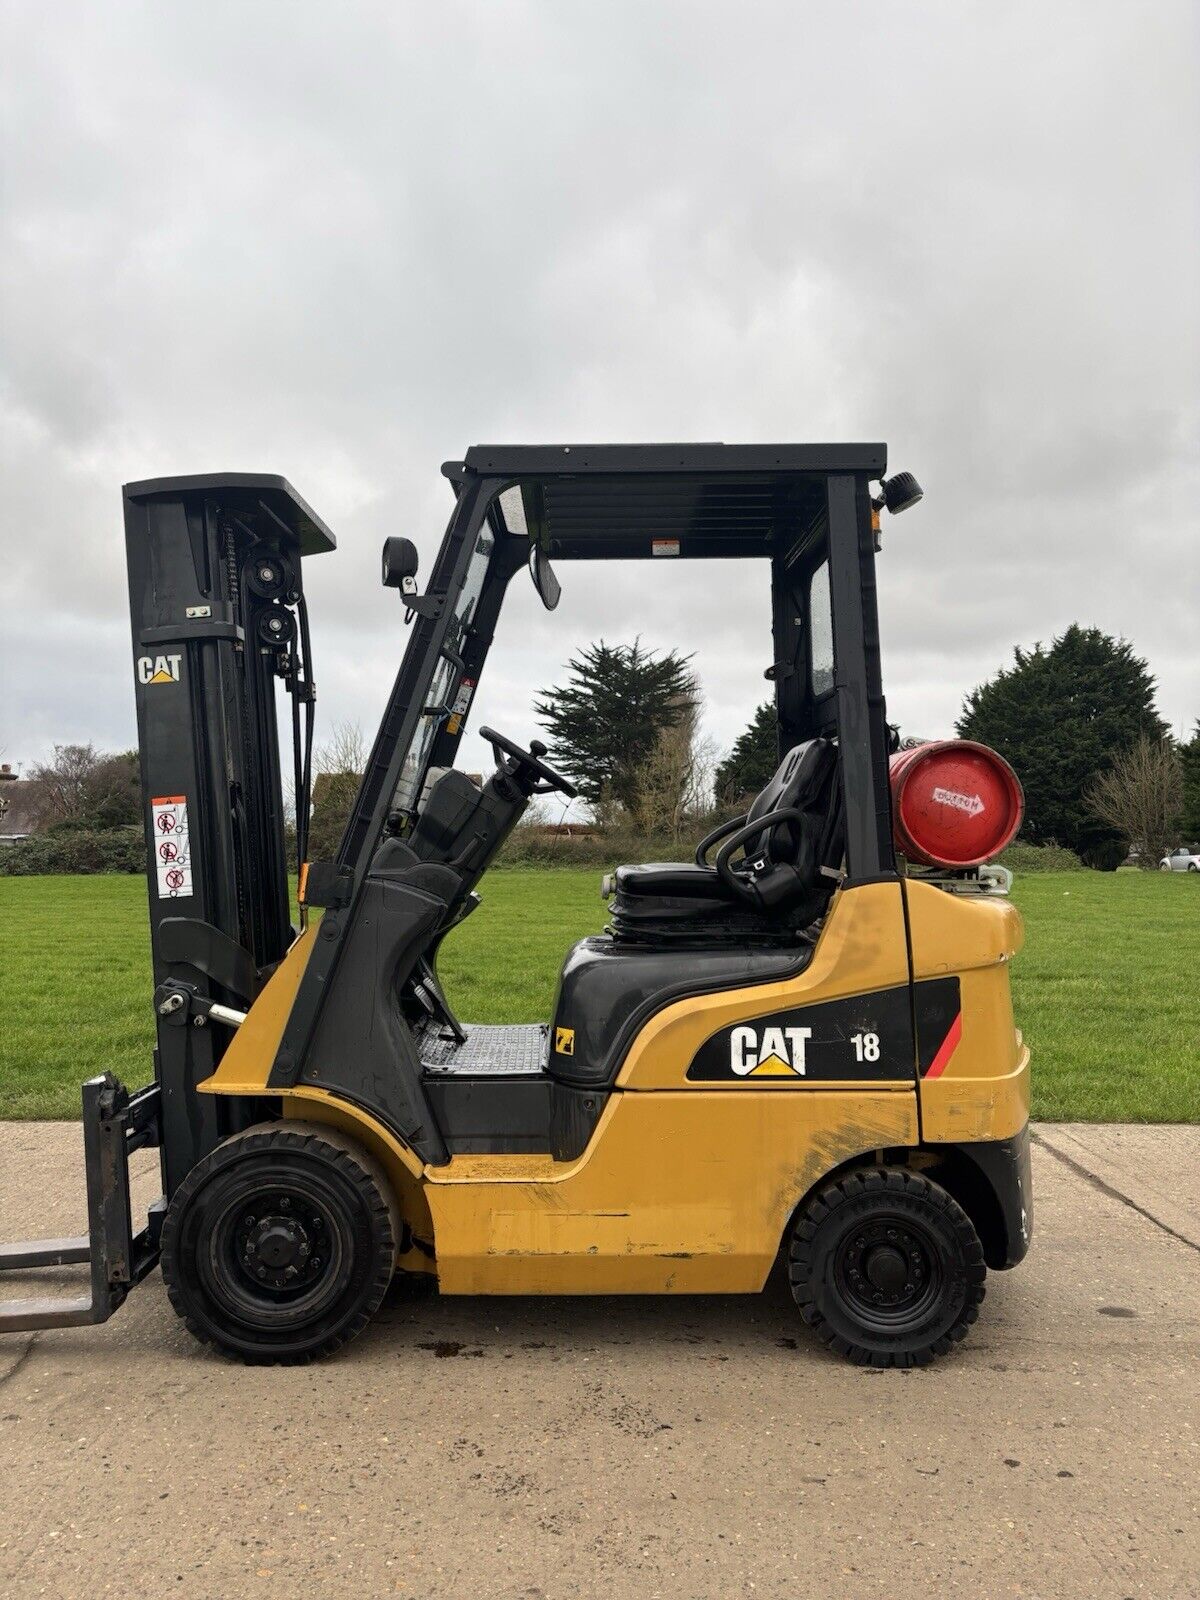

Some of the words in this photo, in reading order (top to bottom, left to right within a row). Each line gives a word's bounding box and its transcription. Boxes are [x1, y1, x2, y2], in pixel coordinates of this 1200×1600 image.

[138, 655, 182, 684] CAT
[730, 1026, 812, 1076] CAT
[850, 1033, 880, 1062] 18
